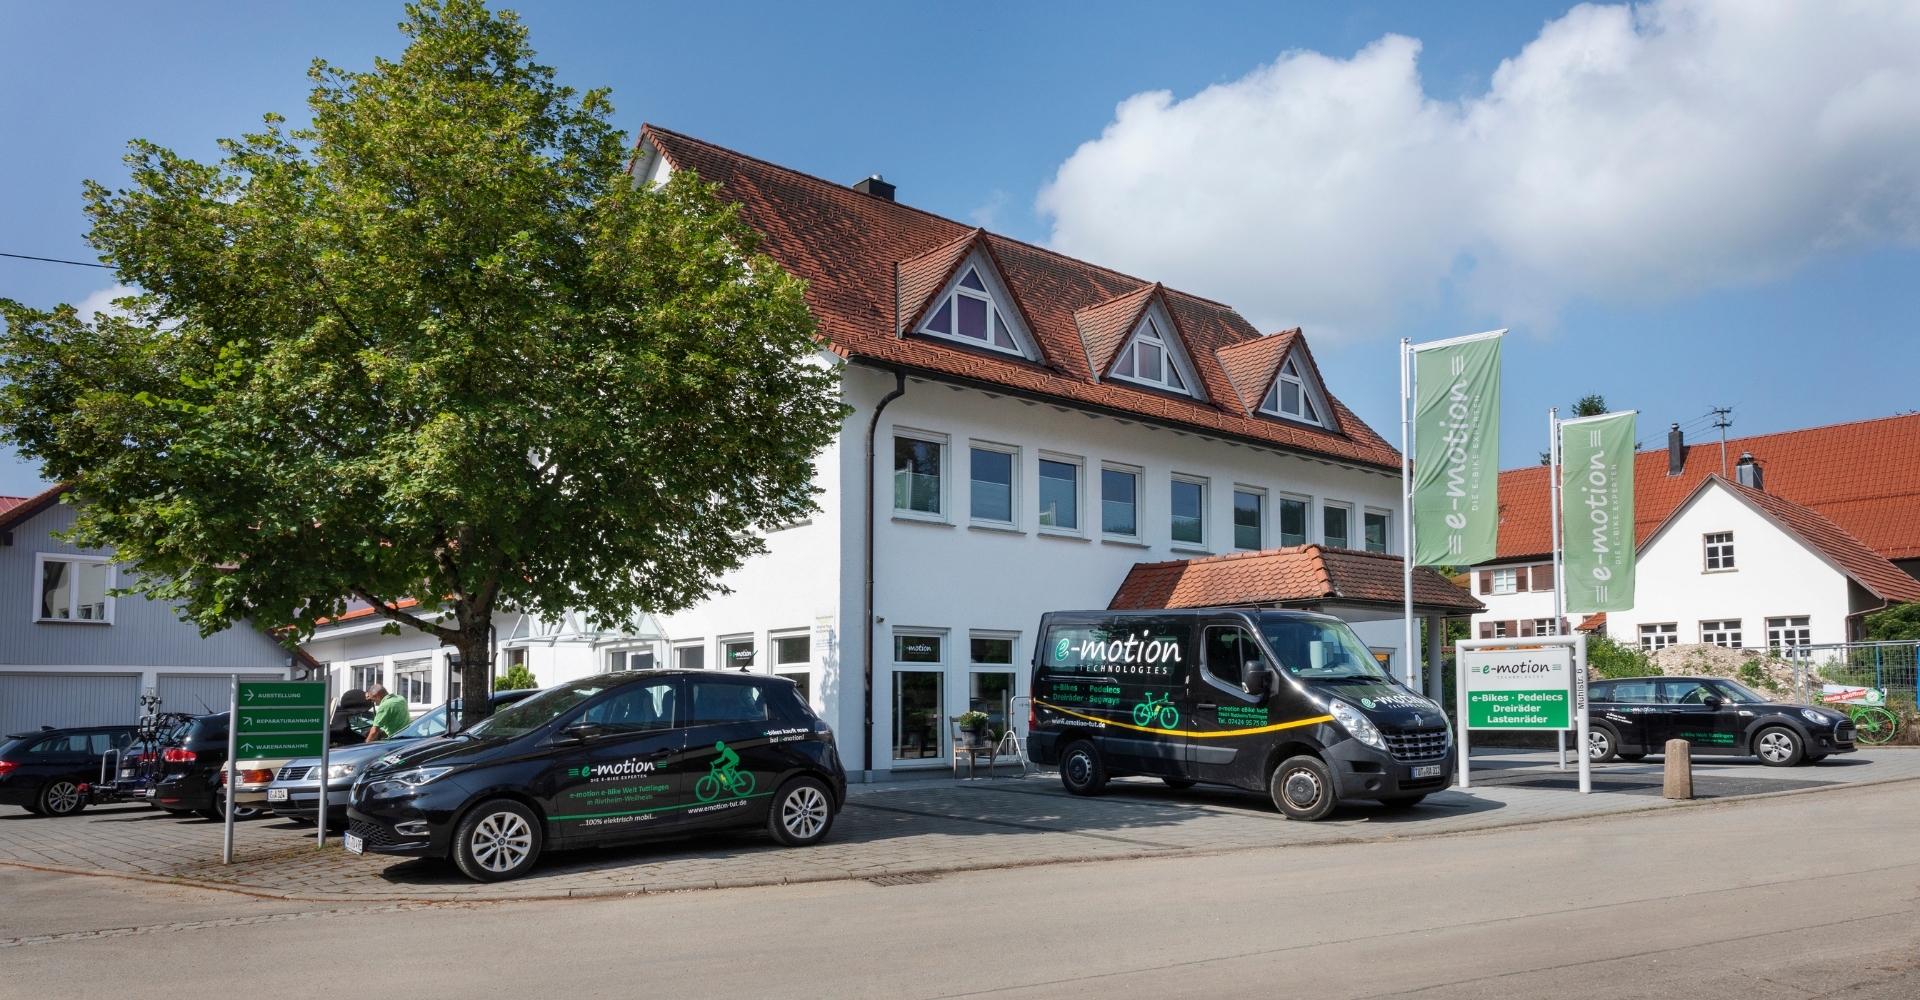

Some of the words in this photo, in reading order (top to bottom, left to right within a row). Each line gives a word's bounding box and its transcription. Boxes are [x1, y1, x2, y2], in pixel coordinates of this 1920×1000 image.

[1473, 395, 1481, 451] EXPERTEN
[1439, 379, 1469, 529] e-motion
[1471, 493, 1479, 511] DIE
[1581, 450, 1611, 581] e-motion
[1055, 629, 1182, 663] e-motion
[1080, 664, 1168, 674] TECHNOLOGIES
[1482, 660, 1550, 675] e-motion
[1053, 684, 1078, 692] e-Bikes
[1089, 685, 1121, 694] Pedelecs
[1841, 690, 1867, 700] geöffnet
[1053, 693, 1084, 702] Dreiräder
[1089, 695, 1120, 705] Segways
[1471, 694, 1509, 702] e-Bikes
[1517, 693, 1563, 701] Pedelecs
[1493, 704, 1541, 712] Dreiräder
[1487, 715, 1548, 723] Lastenräder
[581, 757, 655, 777] e-motion
[569, 790, 600, 799] e-motion
[601, 788, 621, 796] e-Bike
[622, 786, 638, 794] Welt
[638, 784, 670, 793] Tuttlingen
[594, 794, 654, 805] Rietheim-Weilheim
[688, 799, 747, 814] www.emotion-tut.de
[603, 815, 634, 825] elektrisch
